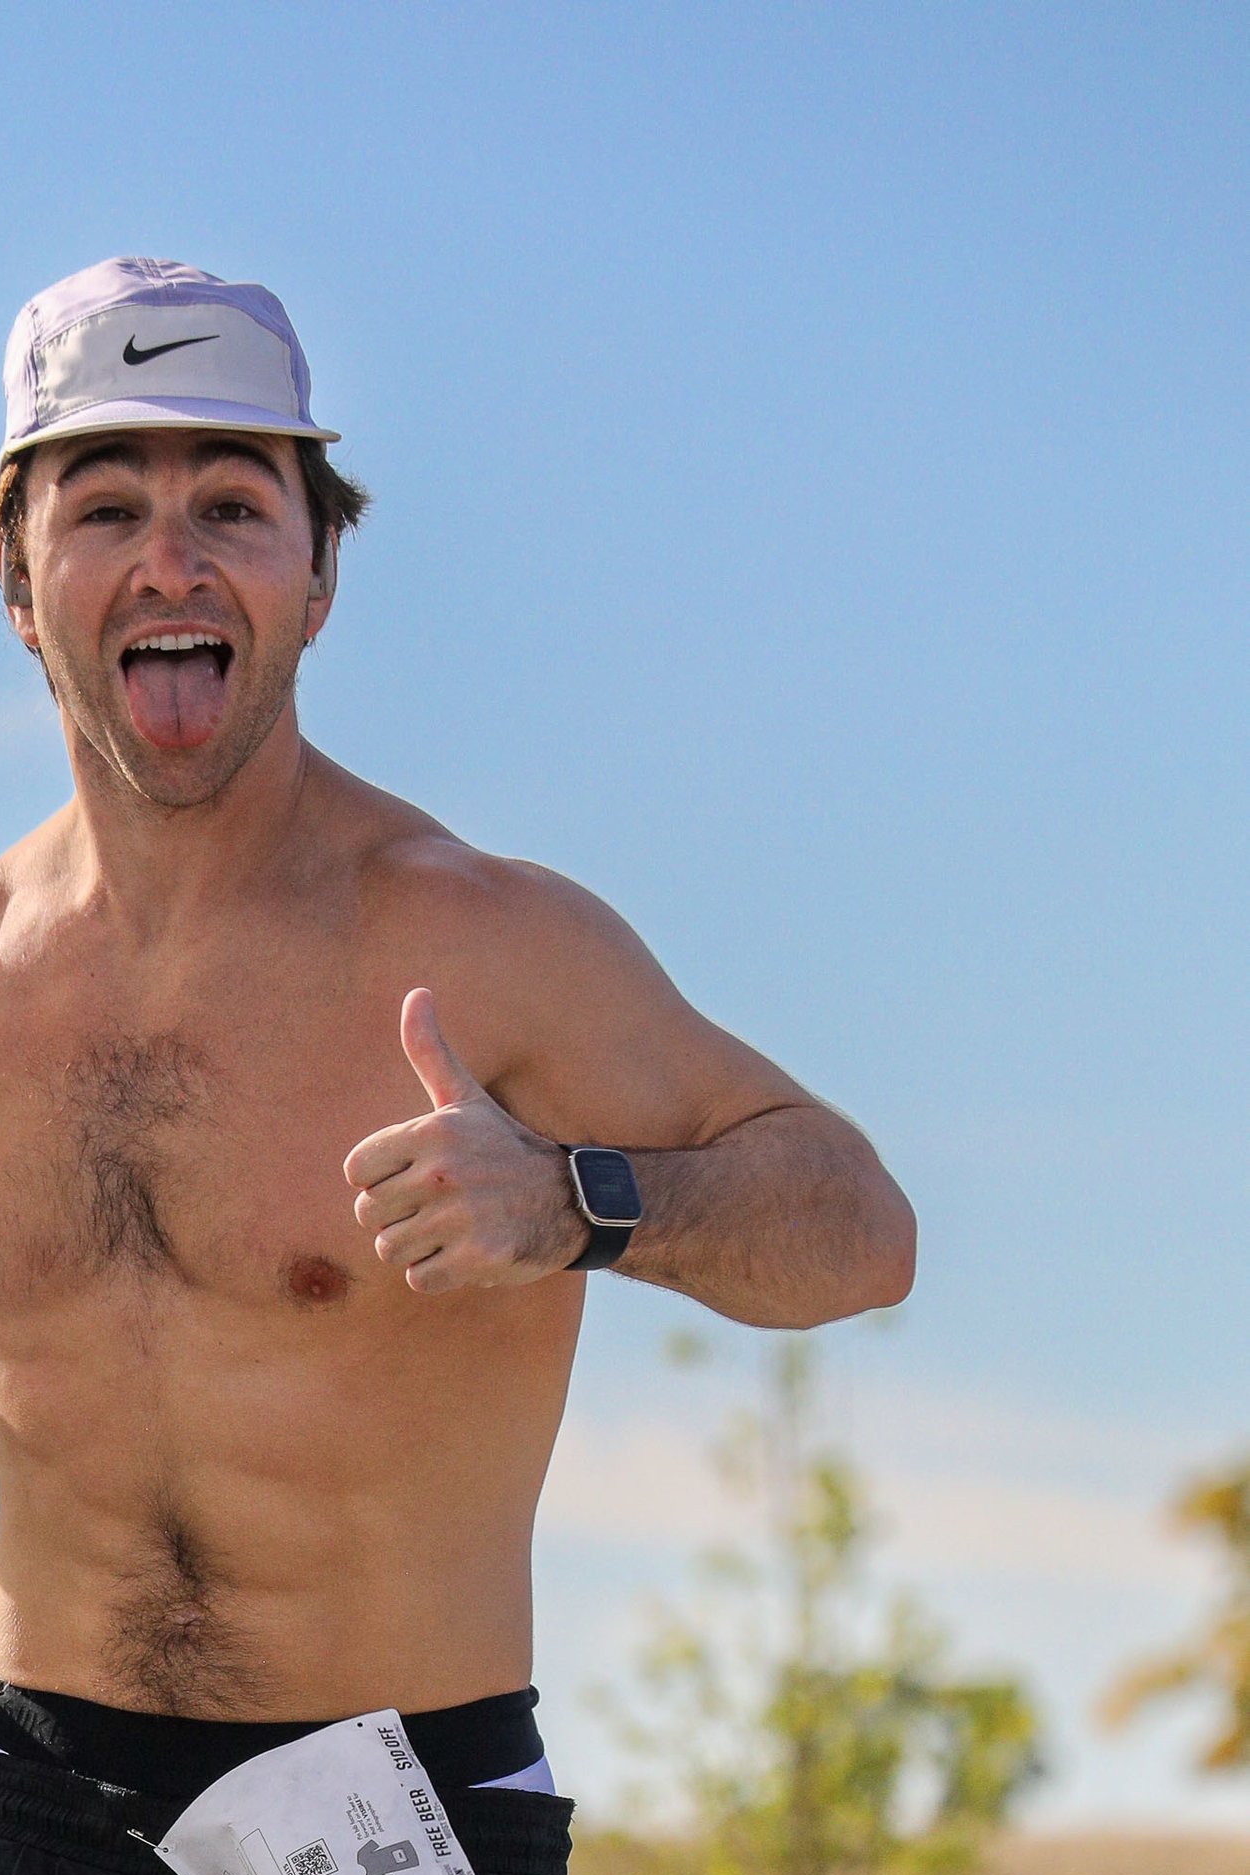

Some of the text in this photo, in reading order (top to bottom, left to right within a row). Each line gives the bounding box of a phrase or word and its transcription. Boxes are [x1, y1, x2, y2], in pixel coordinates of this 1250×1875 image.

[377, 1727, 400, 1748] OFF
[391, 1748, 413, 1771] $10
[354, 1799, 369, 1819] VISIBLE
[409, 1788, 452, 1857] FREE BEER
